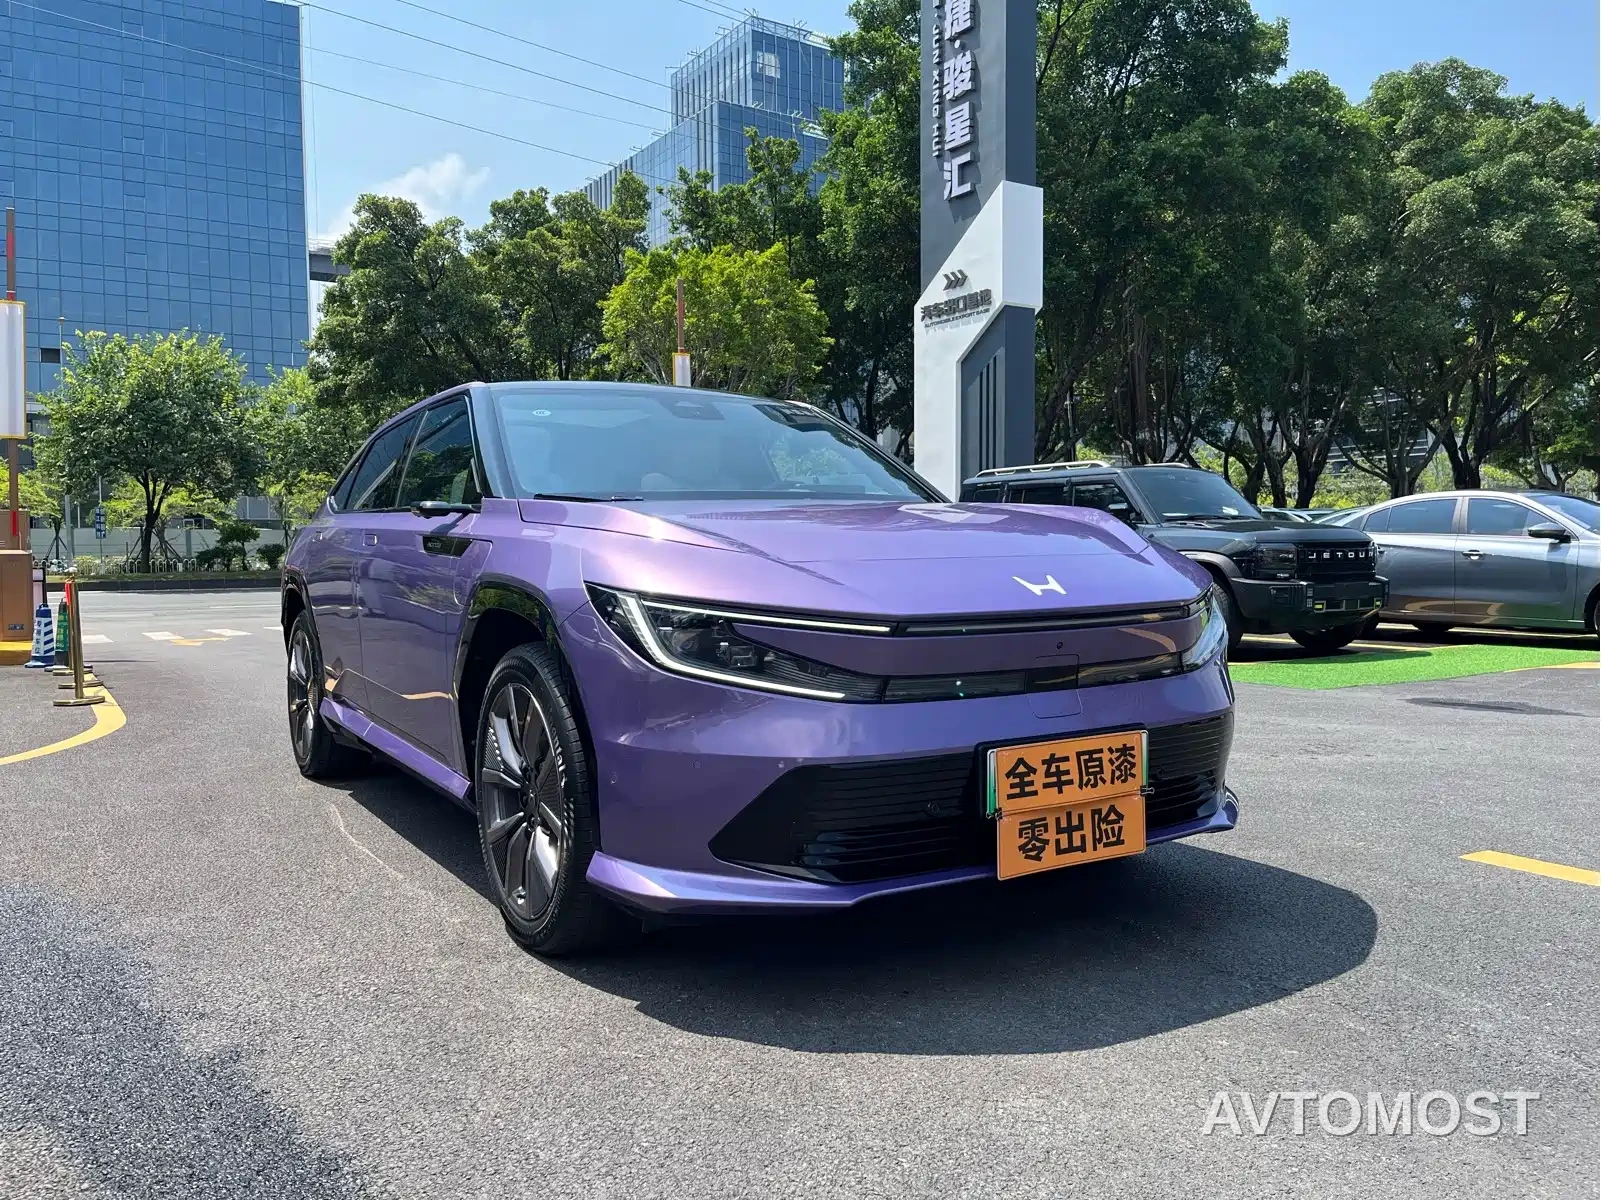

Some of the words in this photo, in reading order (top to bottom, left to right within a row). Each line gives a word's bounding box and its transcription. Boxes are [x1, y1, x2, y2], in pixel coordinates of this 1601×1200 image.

[920, 289, 992, 322] 汽车出口基地
[955, 312, 975, 320] EXPORT
[1308, 551, 1374, 559] JETOUR
[1004, 743, 1137, 800] 全车原漆
[1017, 804, 1125, 862] 零出险
